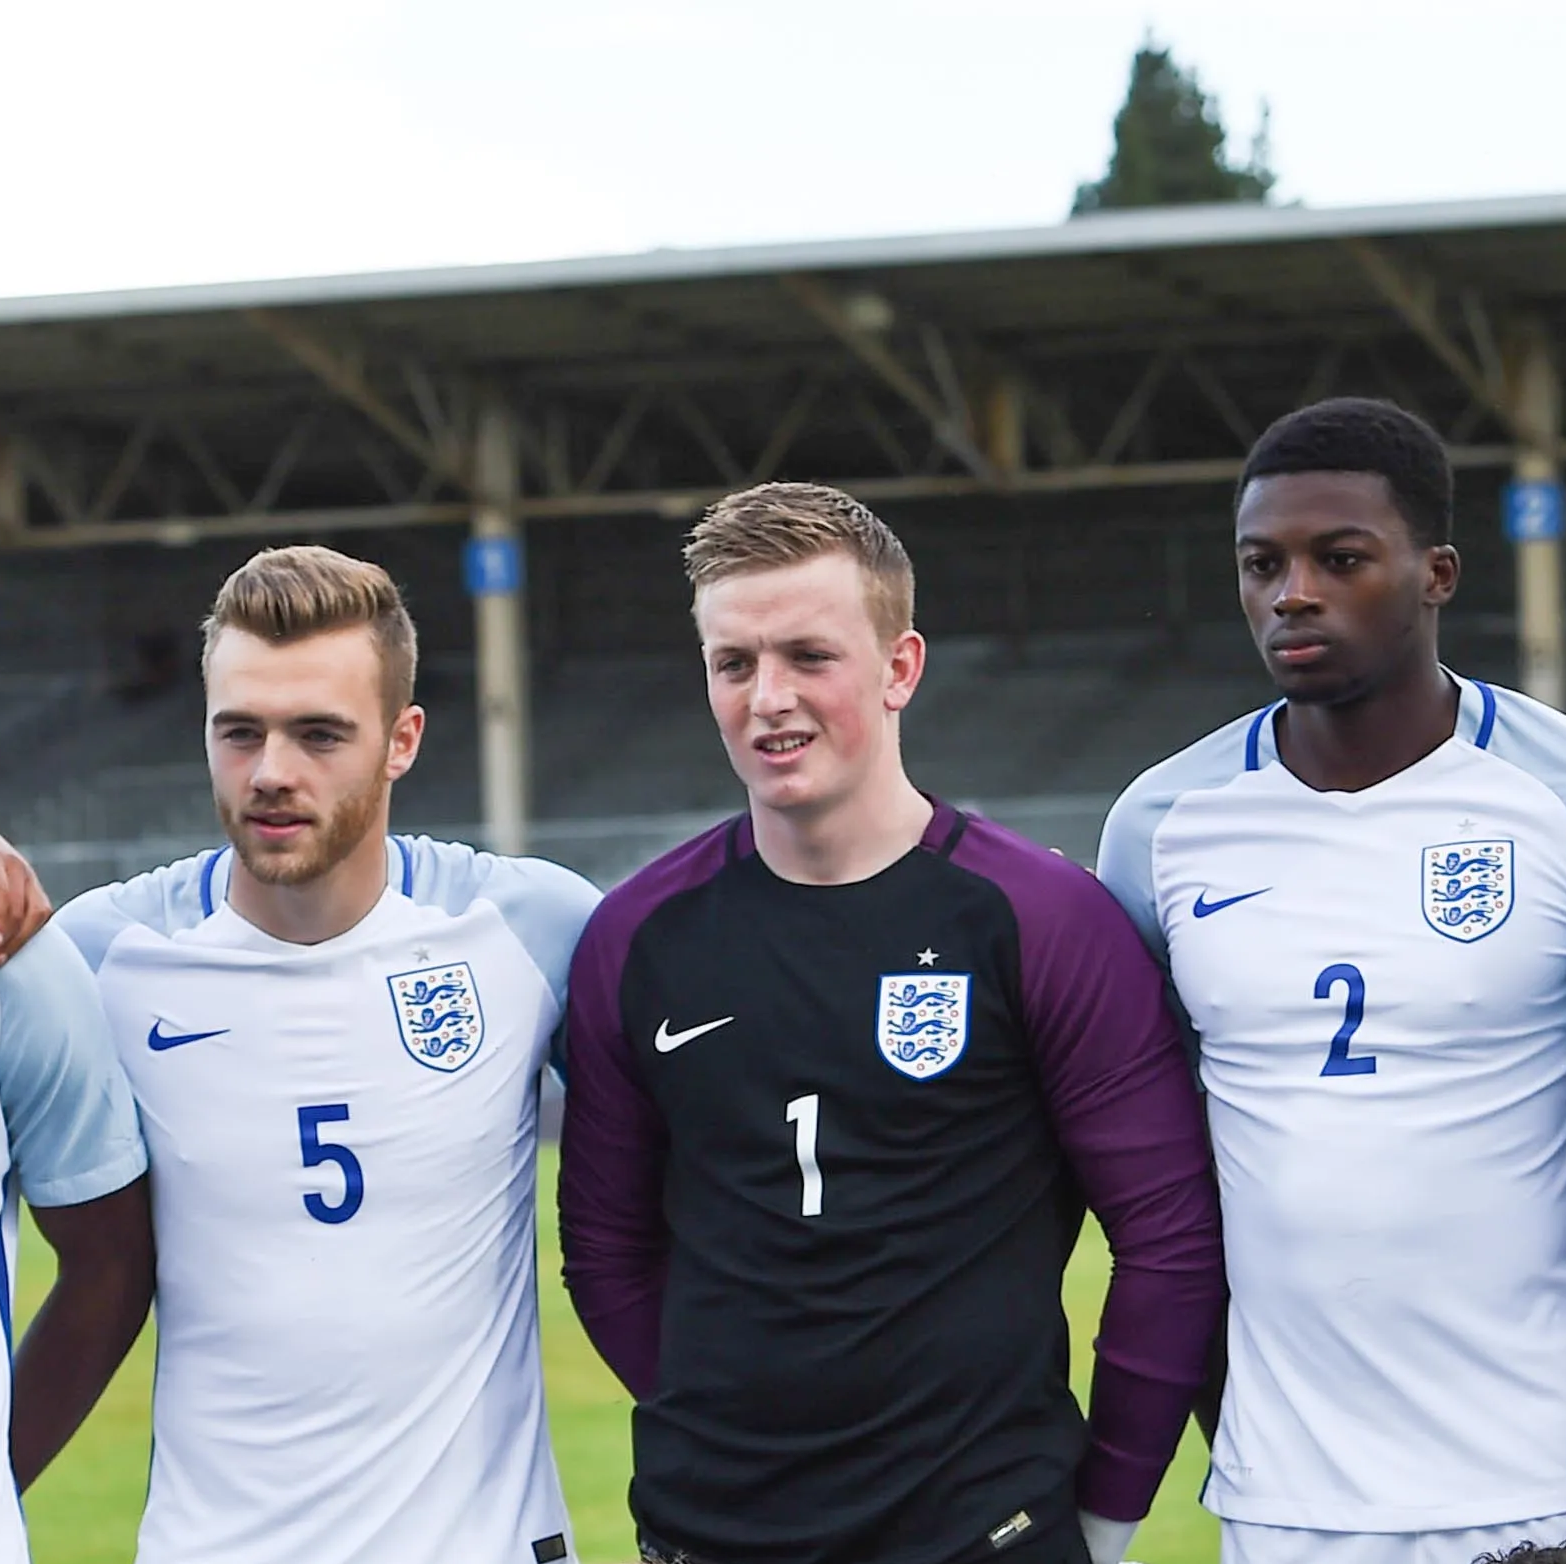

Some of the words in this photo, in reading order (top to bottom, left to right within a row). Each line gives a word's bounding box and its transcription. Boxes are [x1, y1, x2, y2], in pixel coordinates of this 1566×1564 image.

[1313, 962, 1377, 1078] 2
[296, 1102, 365, 1226] 5
[785, 1093, 824, 1217] 1
